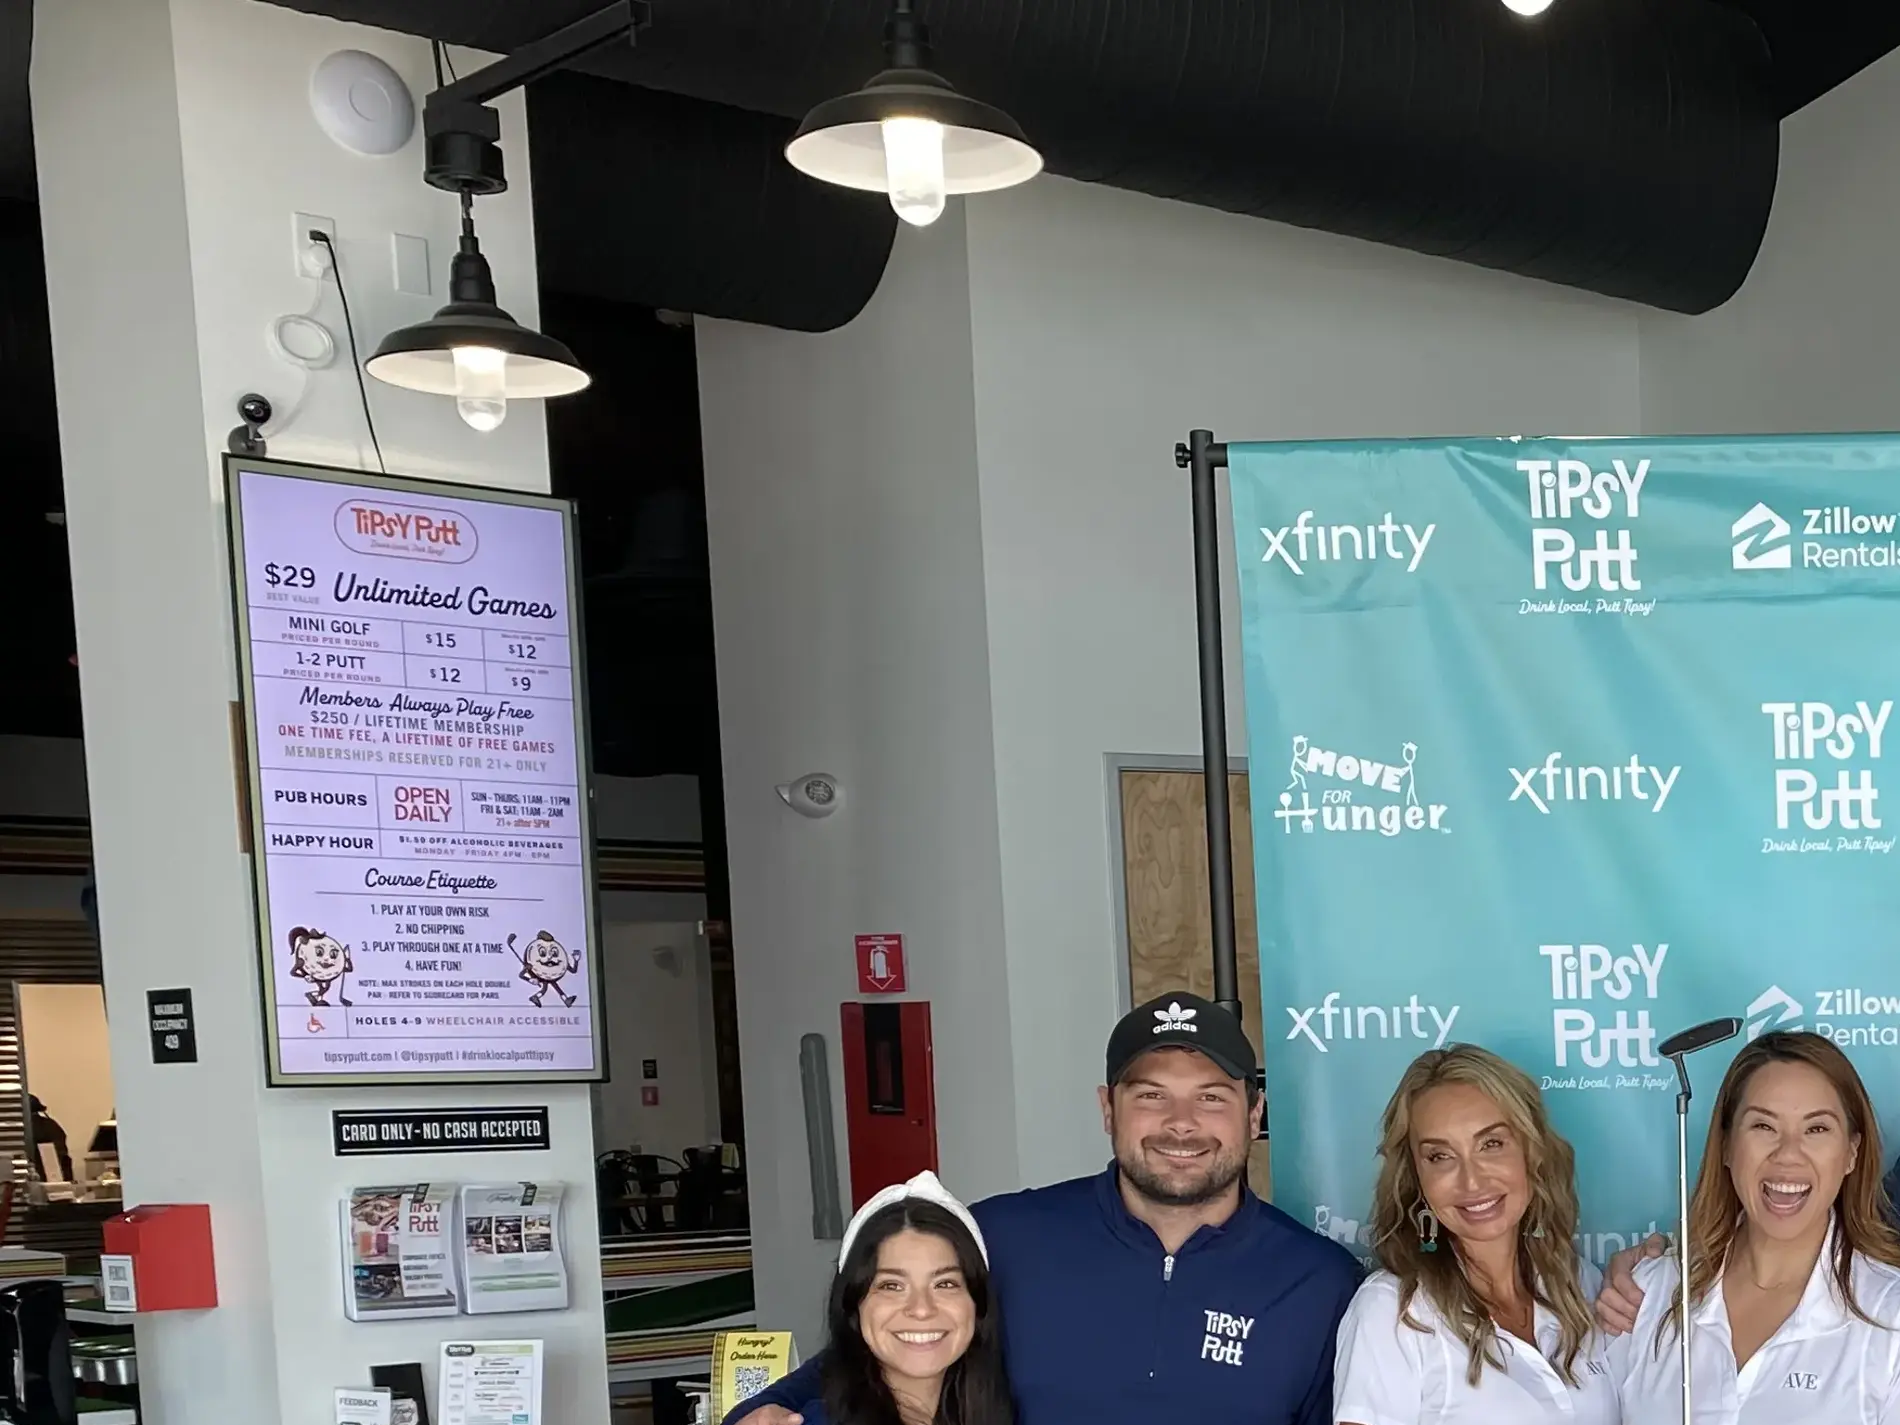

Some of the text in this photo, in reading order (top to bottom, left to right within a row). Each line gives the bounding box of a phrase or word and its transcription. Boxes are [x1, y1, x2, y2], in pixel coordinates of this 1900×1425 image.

[1802, 507, 1899, 536] Zillow
[1259, 510, 1436, 575] xfinity
[265, 562, 315, 588] $29
[333, 572, 557, 619] Unlimited Games
[288, 616, 371, 636] MINI GOLF
[426, 632, 456, 648] $15
[508, 644, 537, 659] $12
[296, 652, 366, 669] 1-2 PUTT
[430, 668, 461, 683] $12
[511, 676, 531, 691] $9
[300, 687, 534, 721] Members Always Play Free
[310, 710, 349, 726] $250
[365, 715, 428, 731] LIFETIME
[434, 719, 524, 736] MEMBERSHIP
[278, 724, 305, 738] ONE
[310, 726, 344, 740] TIME
[382, 732, 390, 743] A
[395, 732, 453, 747] LIFETIME
[459, 736, 474, 748] OF
[478, 737, 508, 751] FREE
[513, 739, 555, 754] GAMES
[284, 745, 383, 762] MEMBERSHIPS
[389, 751, 453, 767] RESERVED
[459, 756, 482, 768] FOR
[516, 759, 547, 772] ONLY
[1306, 746, 1402, 794] MOVE
[274, 791, 368, 807] PUB HOURS
[394, 787, 450, 804] OPEN
[1321, 788, 1351, 805] FOR
[394, 804, 452, 822] DAILY
[272, 834, 374, 850] HAPPY HOUR
[365, 868, 497, 894] Course Etiquette
[382, 905, 403, 915] PLAY
[406, 905, 416, 916] AT
[419, 906, 443, 916] YOUR
[446, 906, 466, 916] OWN
[469, 907, 489, 917] RISK
[406, 924, 418, 934] NO
[421, 924, 464, 935] CHIPPING
[373, 942, 395, 952] PLAY
[398, 942, 440, 952] THROUGH
[443, 943, 460, 953] ONE
[463, 943, 473, 953] AT
[475, 944, 480, 953] A
[482, 944, 503, 953] TIME
[416, 961, 438, 971] HAVE
[441, 961, 462, 971] FUN!
[356, 1017, 580, 1026] HOLES 4-9 WHEELCHAIR ACCESSIBLE
[1153, 1022, 1198, 1034] adidas
[342, 1124, 376, 1142] CARD
[444, 1122, 476, 1139] CASH
[481, 1120, 541, 1138] ACCEPTED
[738, 1337, 775, 1347] Hungry?
[730, 1351, 778, 1361] Order Here
[1782, 1372, 1818, 1391] AVE
[339, 1398, 378, 1407] FEEDBACK
